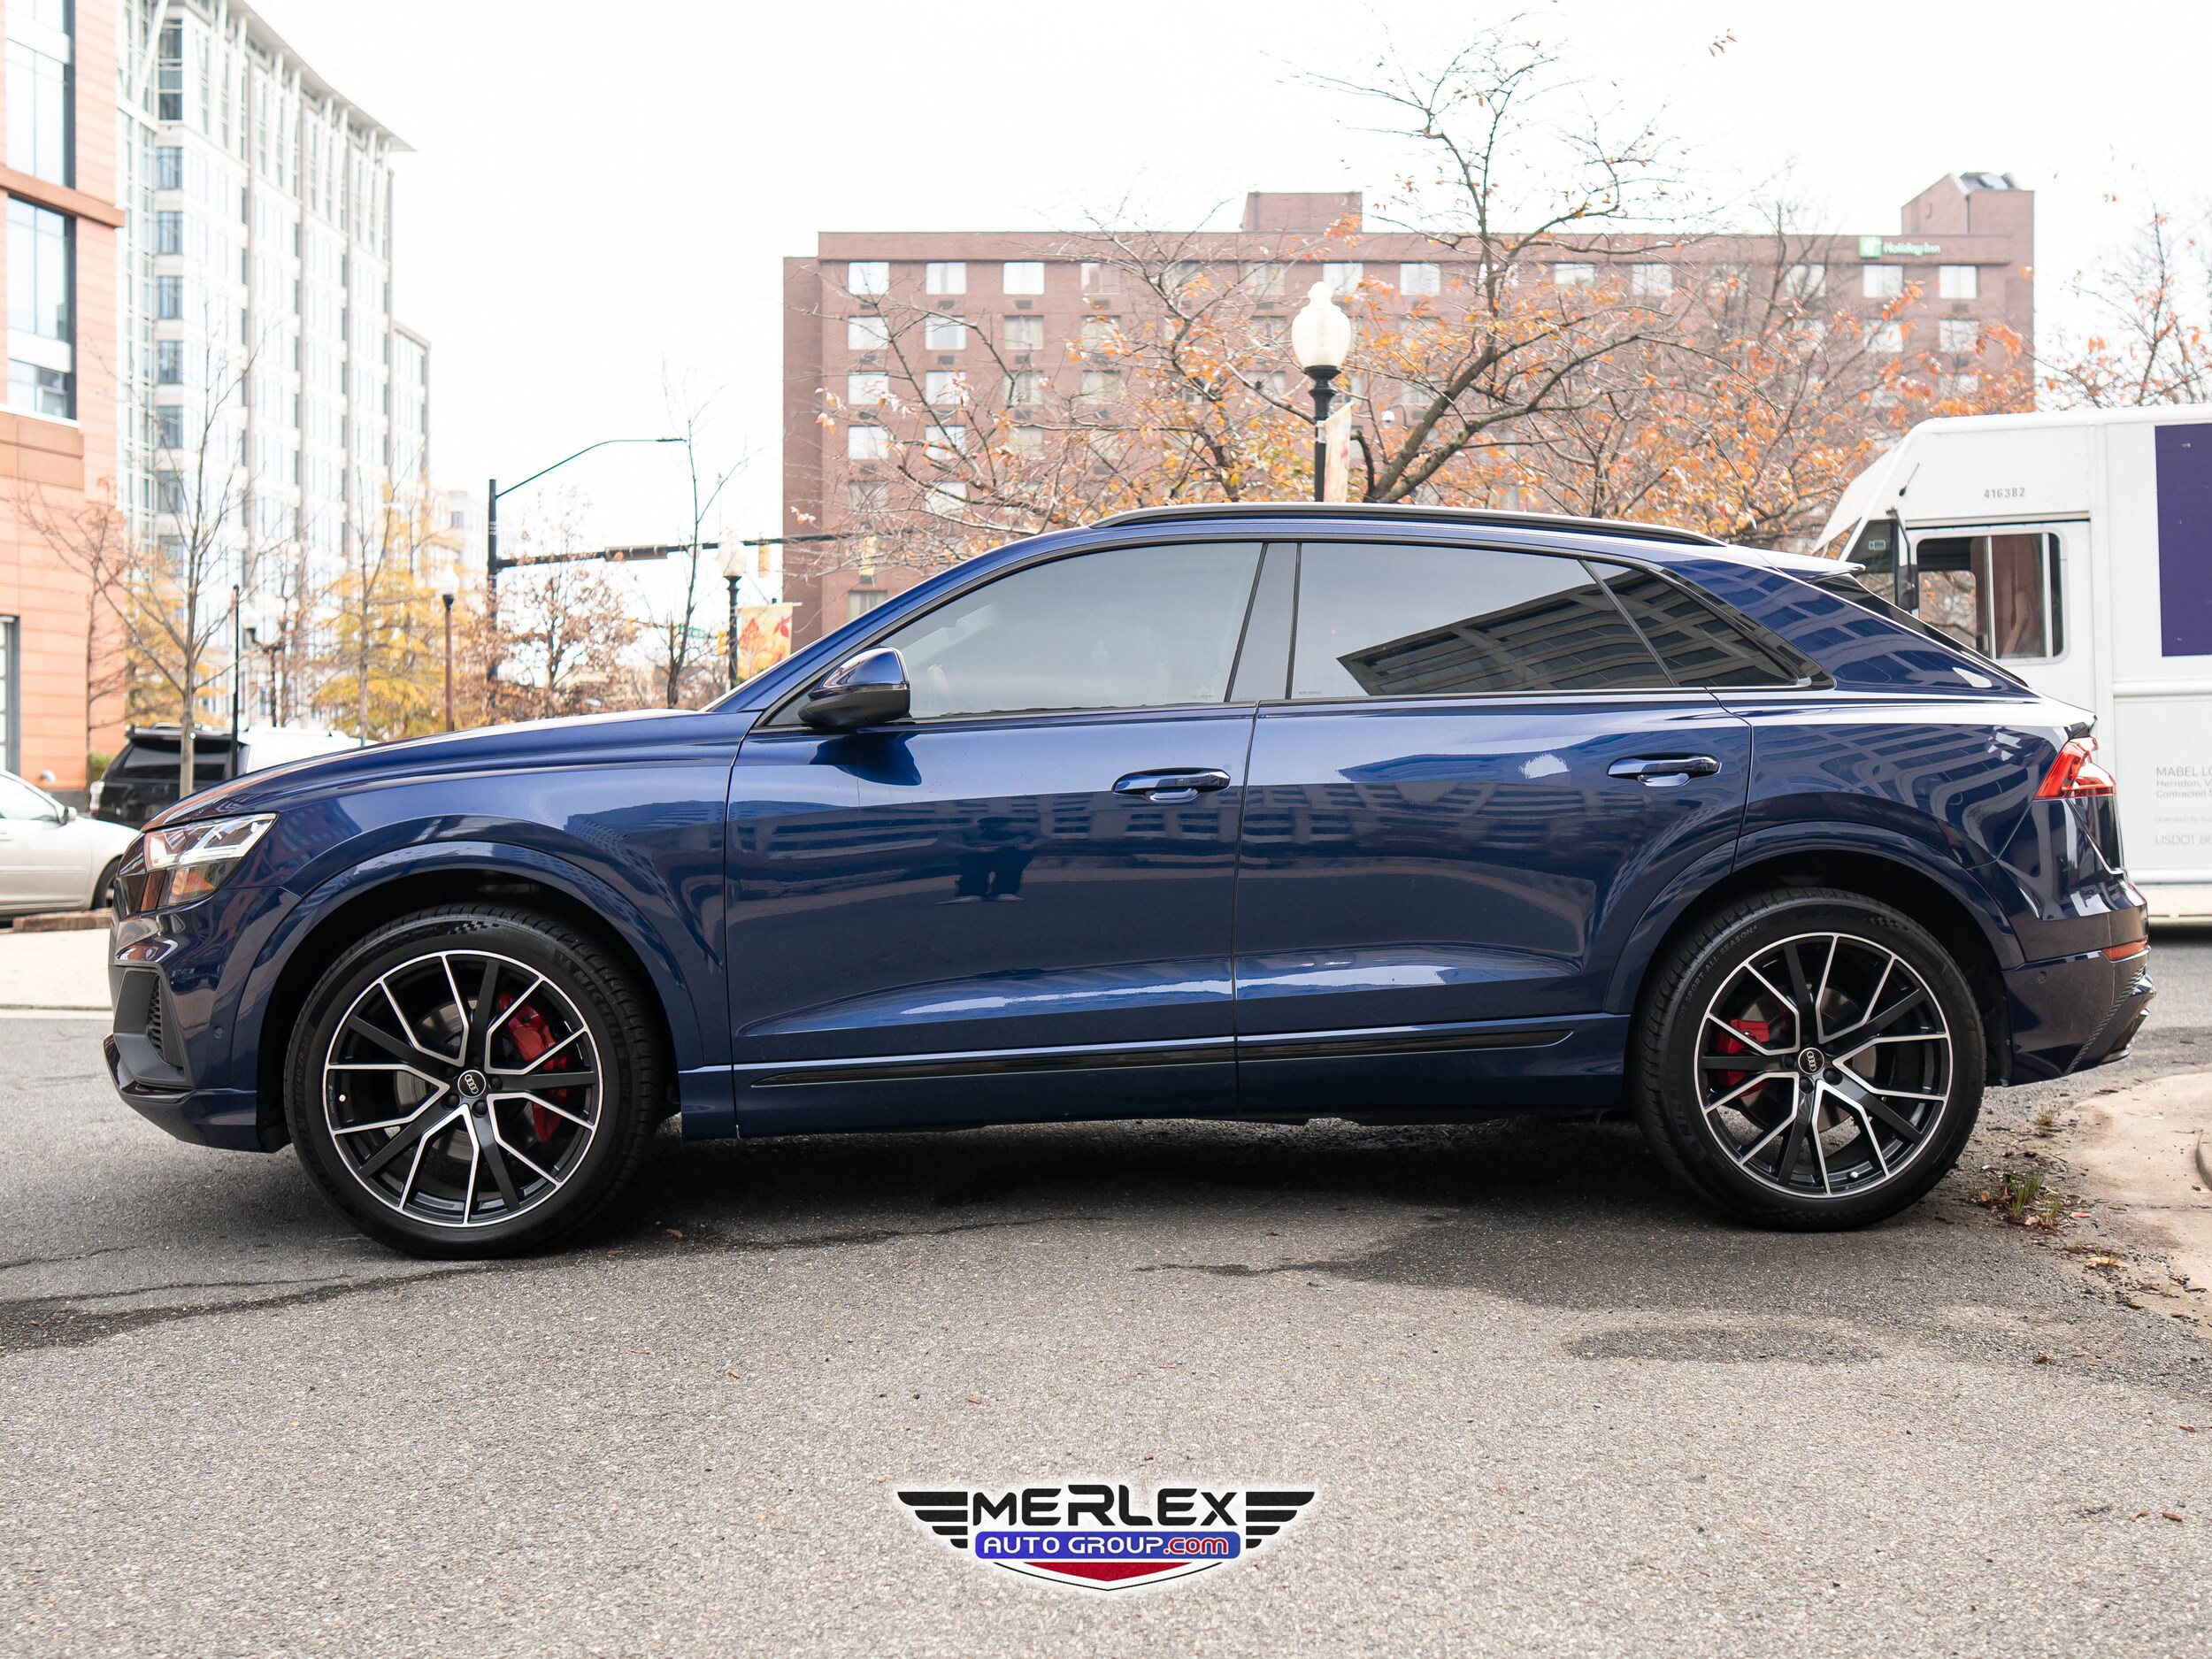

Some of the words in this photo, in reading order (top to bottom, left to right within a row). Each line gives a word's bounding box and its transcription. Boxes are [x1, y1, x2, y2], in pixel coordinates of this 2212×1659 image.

[1984, 487, 2025, 498] 416382
[2156, 766, 2199, 777] MABEL
[2155, 834, 2195, 846] USDOT
